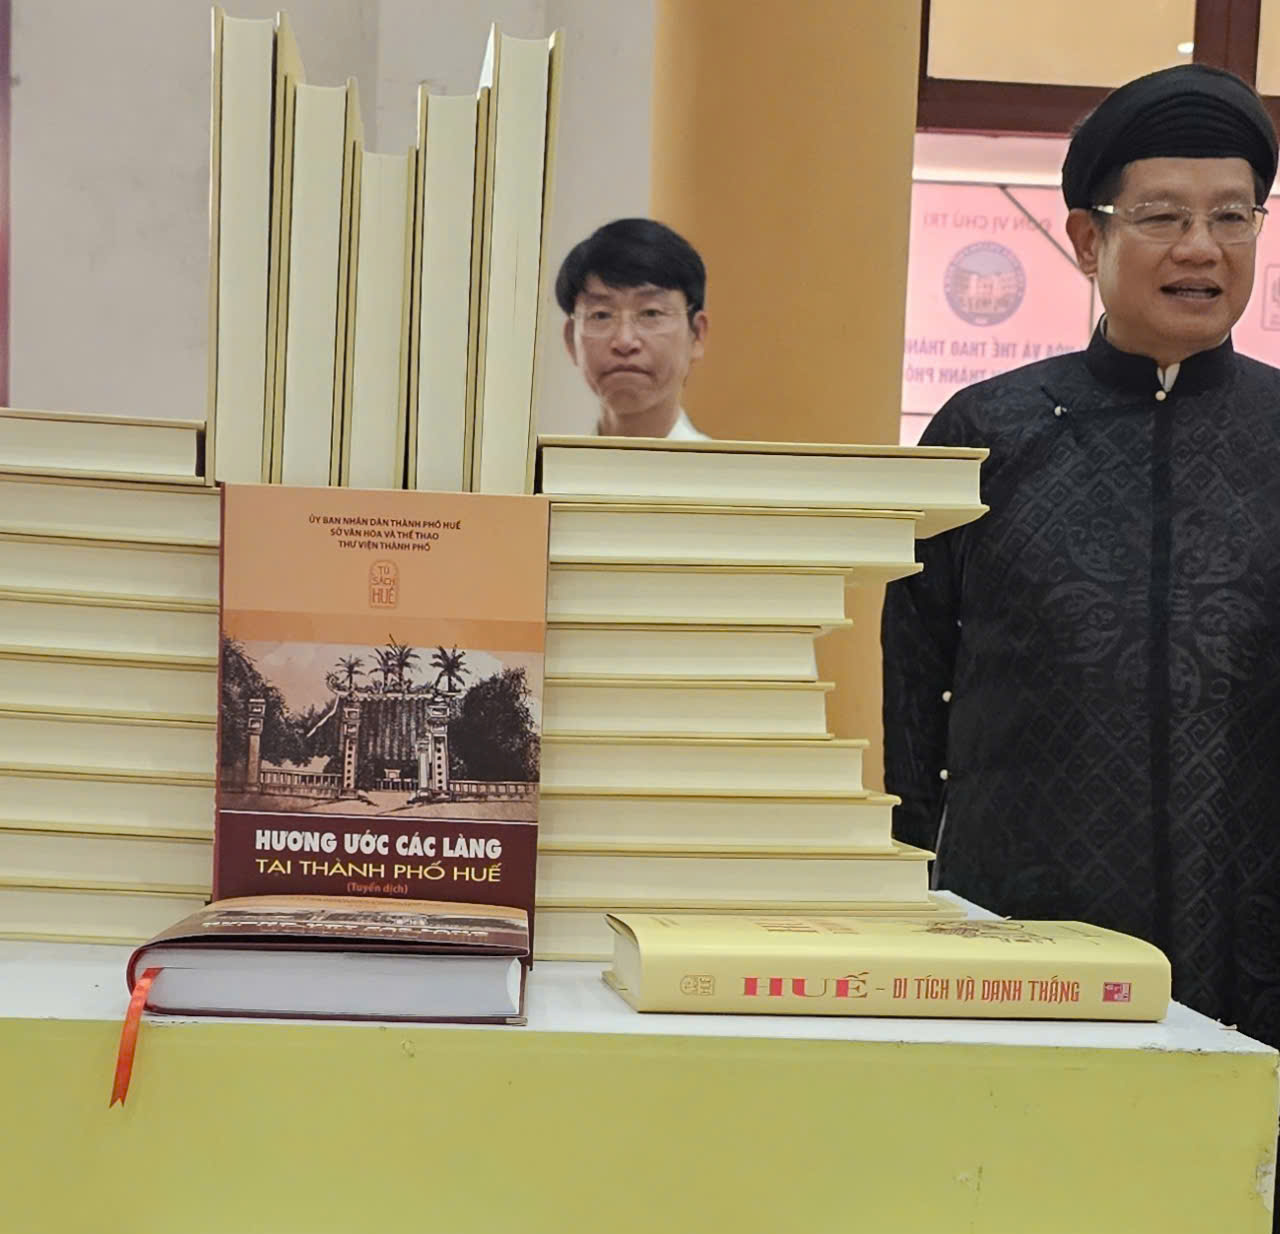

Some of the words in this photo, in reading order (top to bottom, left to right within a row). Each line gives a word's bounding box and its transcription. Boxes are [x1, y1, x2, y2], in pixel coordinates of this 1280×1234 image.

[323, 516, 340, 525] BAN
[443, 520, 461, 530] HUẾ
[416, 531, 439, 540] THAO
[256, 829, 337, 853] HƯƠNG
[344, 829, 389, 855] ƯỚC
[396, 832, 436, 857] CÁC
[443, 834, 502, 859] LÀNG
[256, 859, 291, 877] TẠI
[300, 858, 385, 878] THÀNH
[394, 860, 445, 880] PHỐ
[453, 863, 502, 882] HUẾ
[741, 972, 870, 999] HUẾ
[892, 978, 907, 1000] DI
[913, 974, 949, 1001] TÍCH
[956, 976, 974, 1003] VÀ
[982, 979, 1022, 1004] DANH
